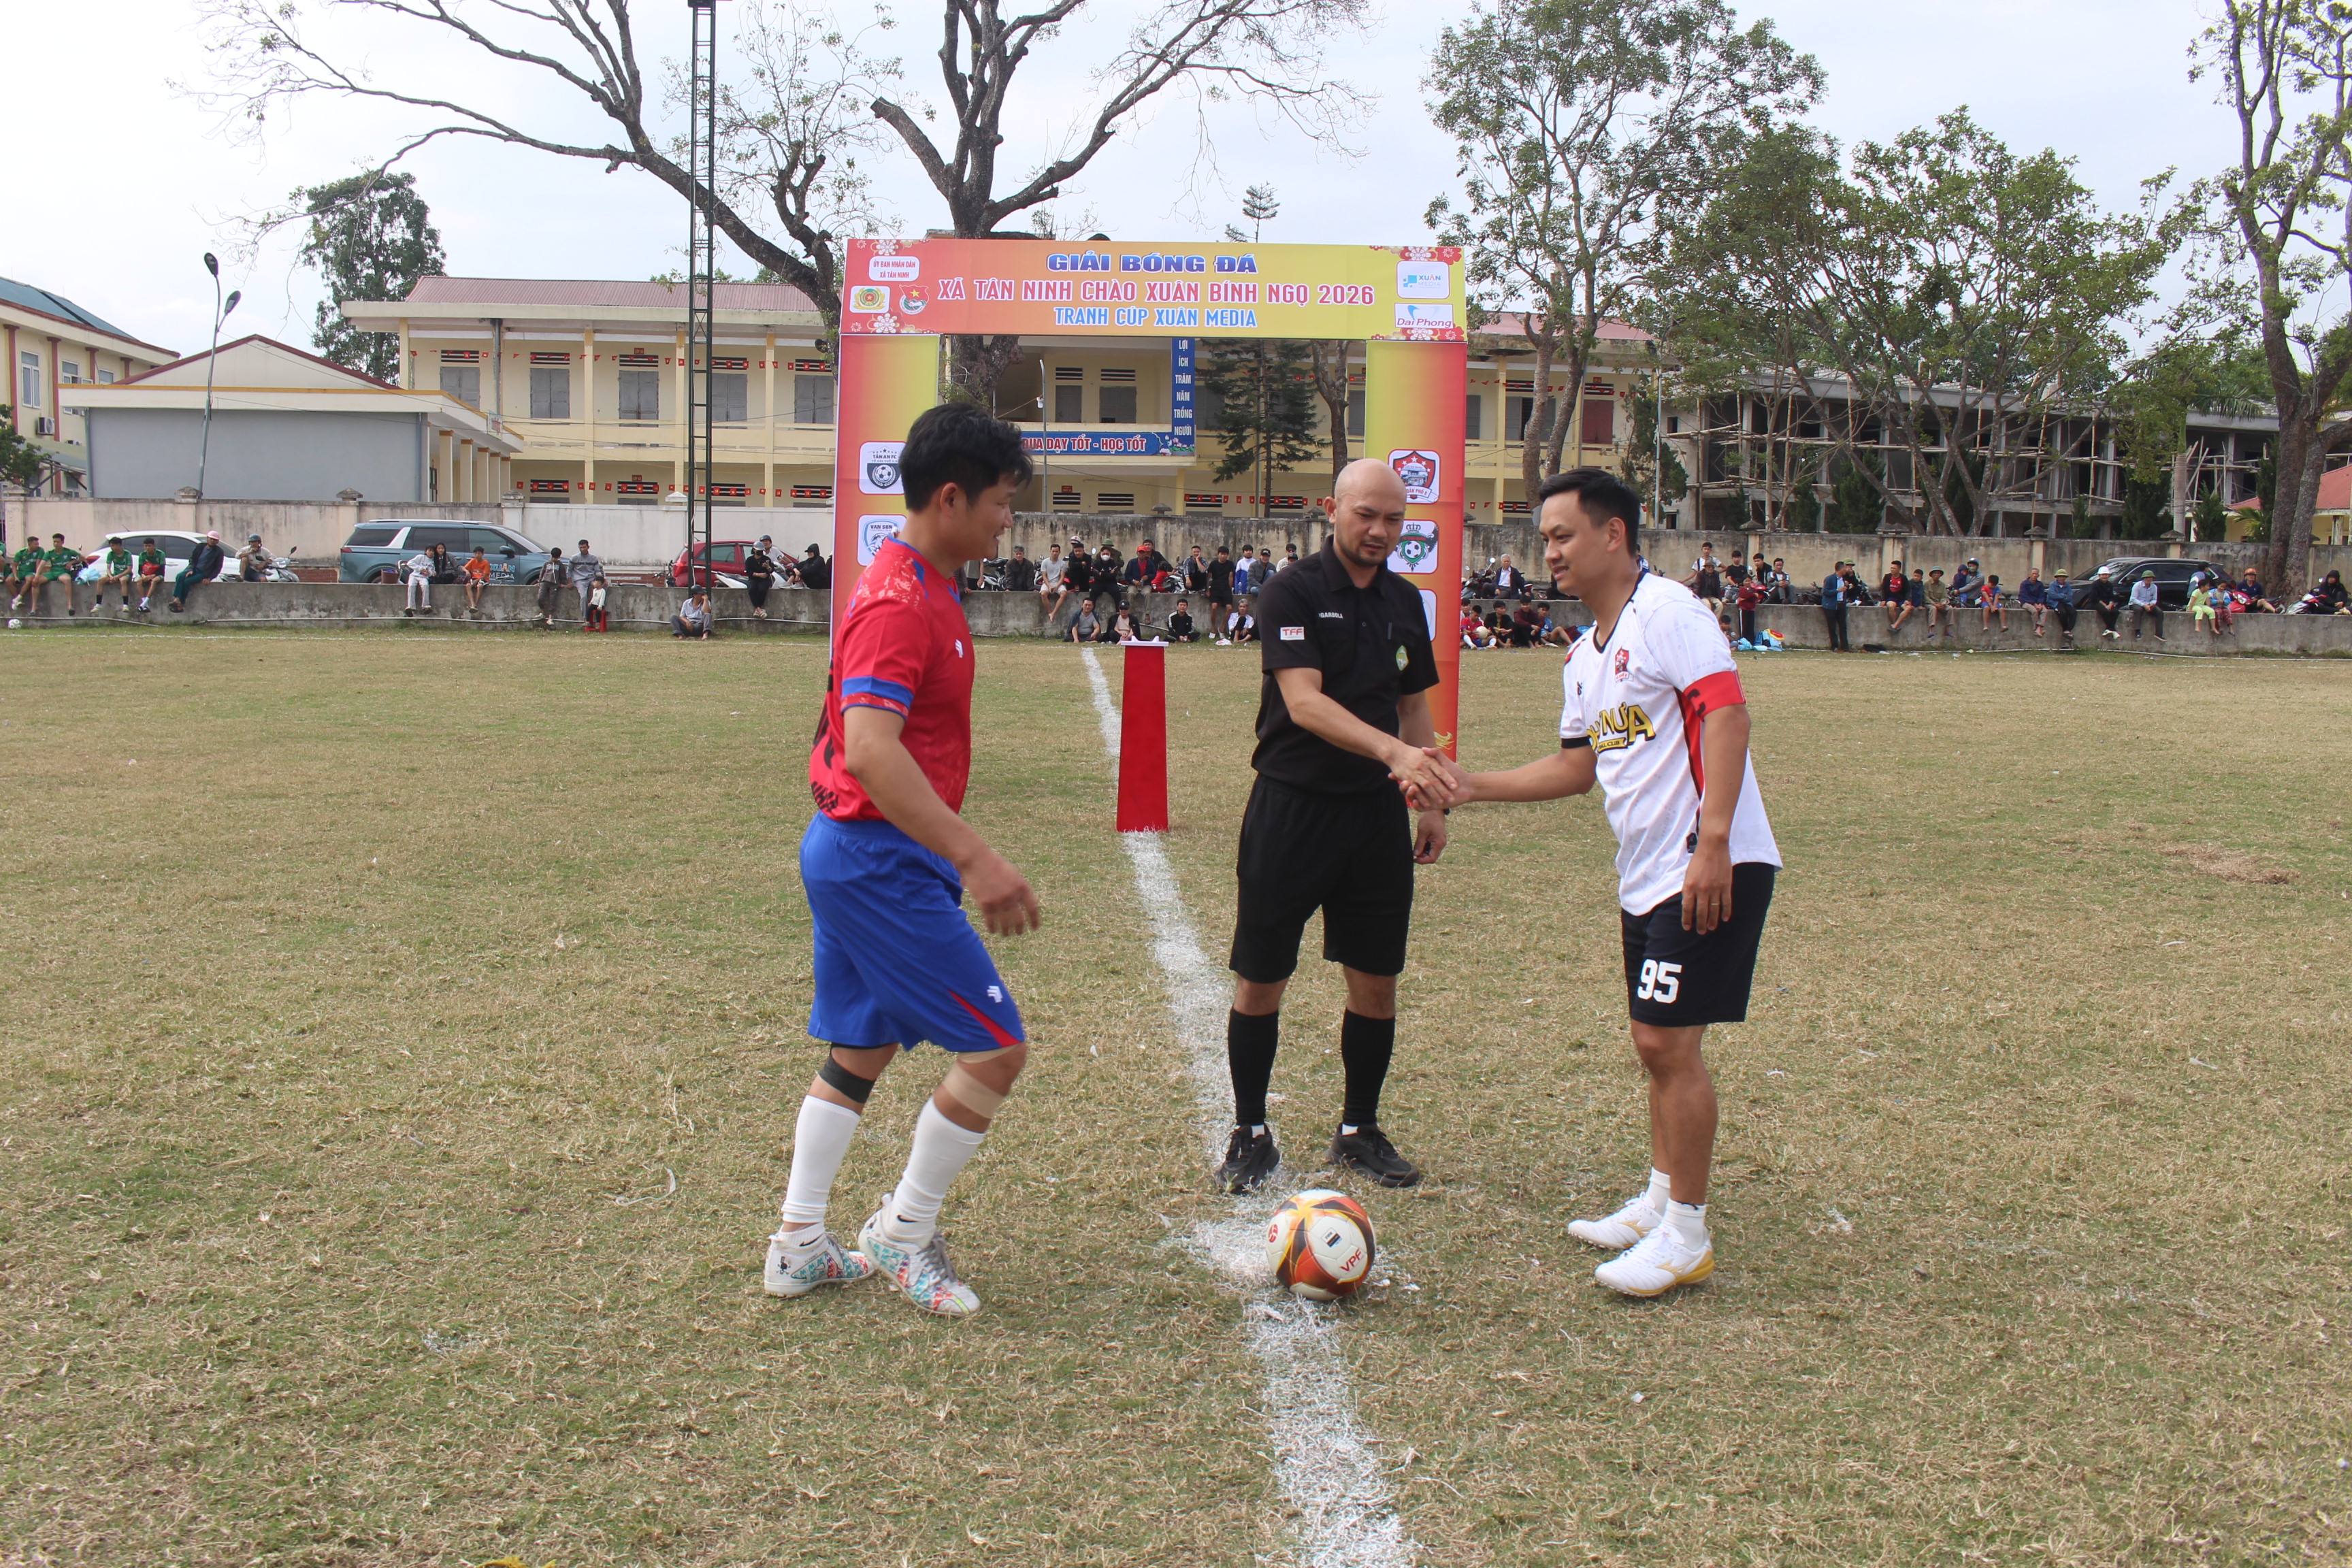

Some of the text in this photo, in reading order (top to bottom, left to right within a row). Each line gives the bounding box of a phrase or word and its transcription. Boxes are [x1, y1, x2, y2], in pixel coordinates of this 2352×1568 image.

[1047, 250, 1258, 273] GIẢI BÓNG ĐÁ
[938, 278, 1375, 306] XÃ TÂN NINH CHÀO XUÂN BÍNH NGỌ 2026
[1054, 306, 1258, 327] TRANH CÚP XUÂN MEDIA
[1416, 318, 1452, 328] Phong
[1179, 340, 1188, 351] LỢI
[1178, 355, 1188, 366] ÍCH
[1175, 373, 1192, 384] TRĂM
[1176, 390, 1190, 401] NĂM
[1046, 437, 1069, 453] DẠY
[1071, 434, 1092, 451] TỐT
[1100, 438, 1124, 454] HỌC
[1126, 434, 1146, 451] TỐT
[489, 563, 515, 572] XUÂN
[1637, 958, 1682, 1004] 95
[1339, 1248, 1362, 1272] VPF
